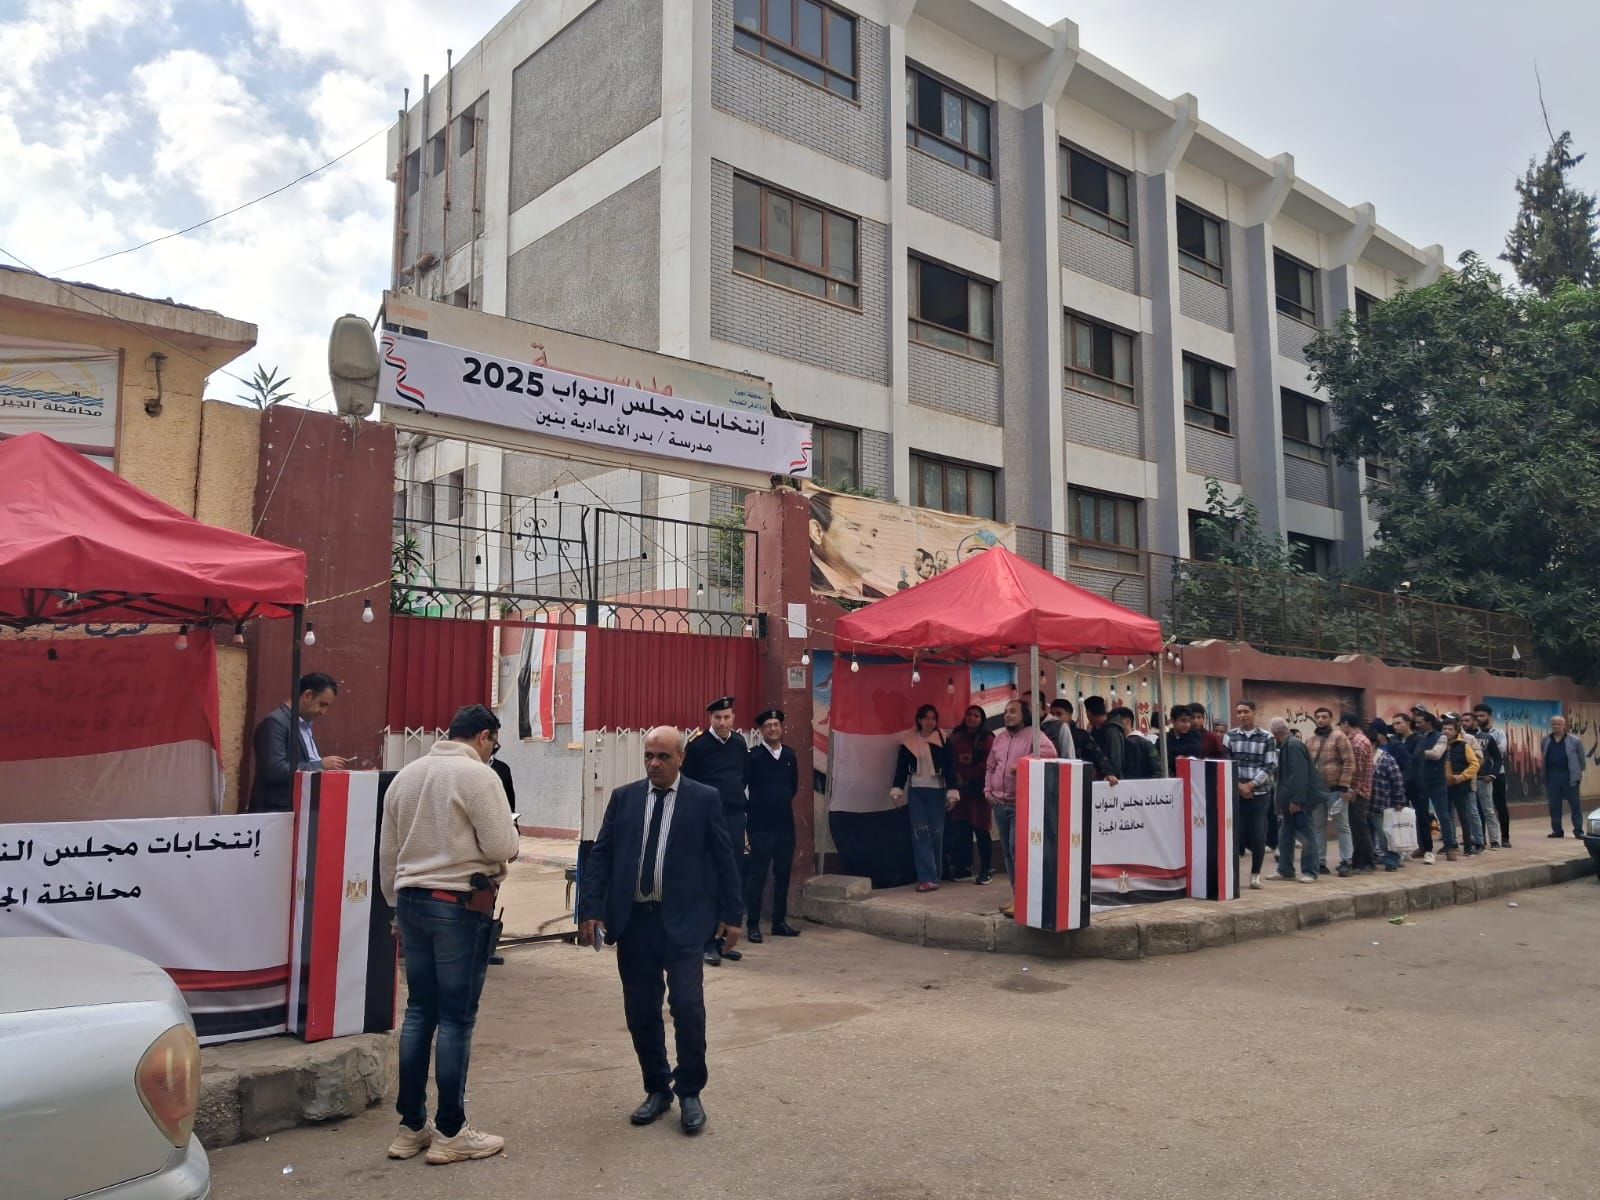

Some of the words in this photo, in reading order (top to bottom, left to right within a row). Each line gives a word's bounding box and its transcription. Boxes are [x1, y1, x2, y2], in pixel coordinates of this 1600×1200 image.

[462, 356, 545, 398] 2025
[0, 398, 36, 409] الجيز
[552, 380, 614, 407] النواب
[43, 401, 102, 417] محافظة
[535, 410, 566, 430] بنين
[621, 397, 685, 423] مجلس
[570, 412, 630, 437] الأعدادية
[690, 409, 765, 446] إنتخابات
[632, 430, 653, 446] بدر
[668, 431, 713, 453] مدرسة
[1094, 796, 1119, 813] النواب
[1120, 796, 1144, 812] مجلس
[1098, 821, 1118, 836] الجيزة
[1118, 819, 1145, 832] محافظة
[0, 838, 34, 862] الن
[43, 836, 139, 867] مجلس
[147, 829, 261, 858] إنتخابات
[0, 886, 29, 912] الج
[37, 881, 142, 905] محافظة
